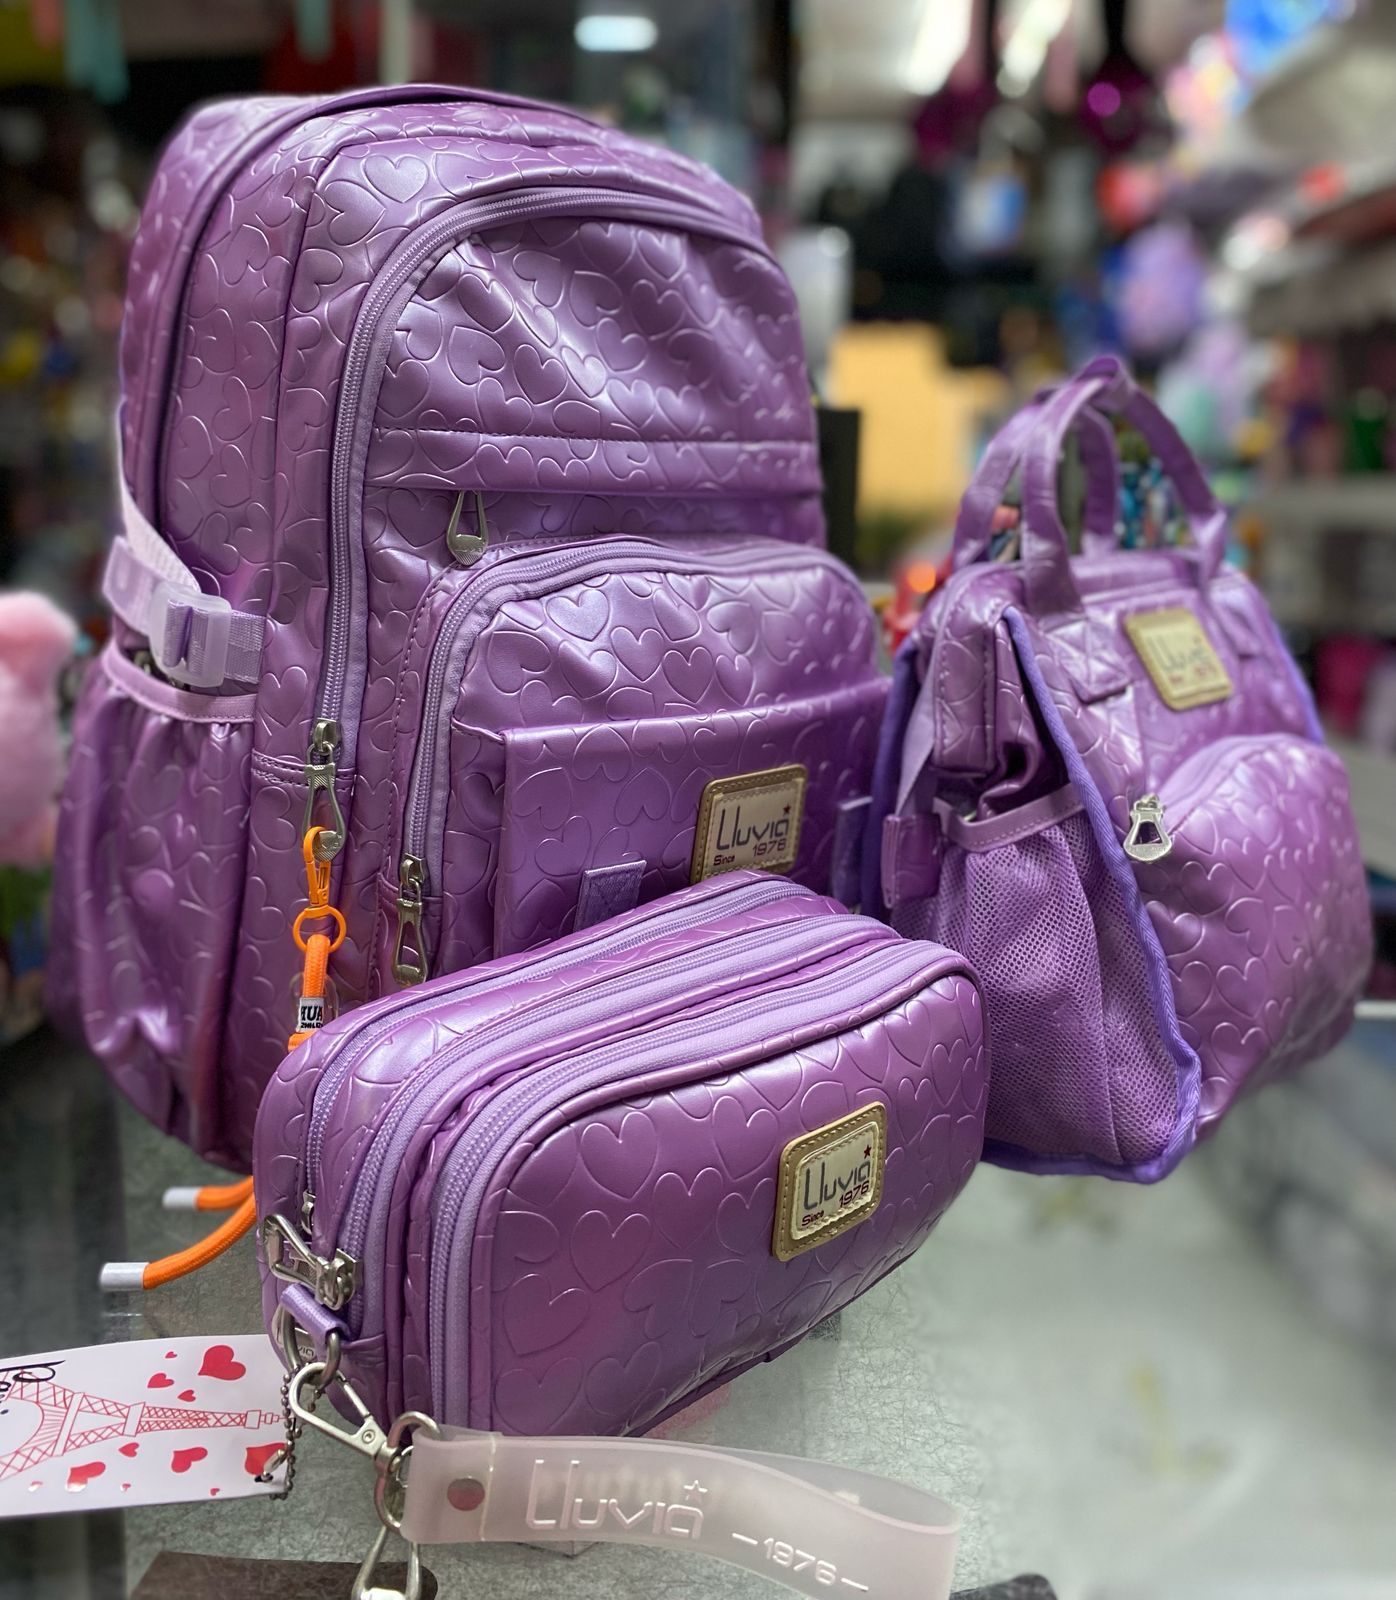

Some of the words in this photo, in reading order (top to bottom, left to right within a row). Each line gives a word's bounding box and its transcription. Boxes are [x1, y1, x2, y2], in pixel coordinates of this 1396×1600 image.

[716, 805, 789, 851] Lluvia
[752, 838, 787, 857] 1976
[803, 1160, 871, 1211] Lluvia
[839, 1180, 870, 1208] 1976
[525, 1459, 705, 1540] Lluvia
